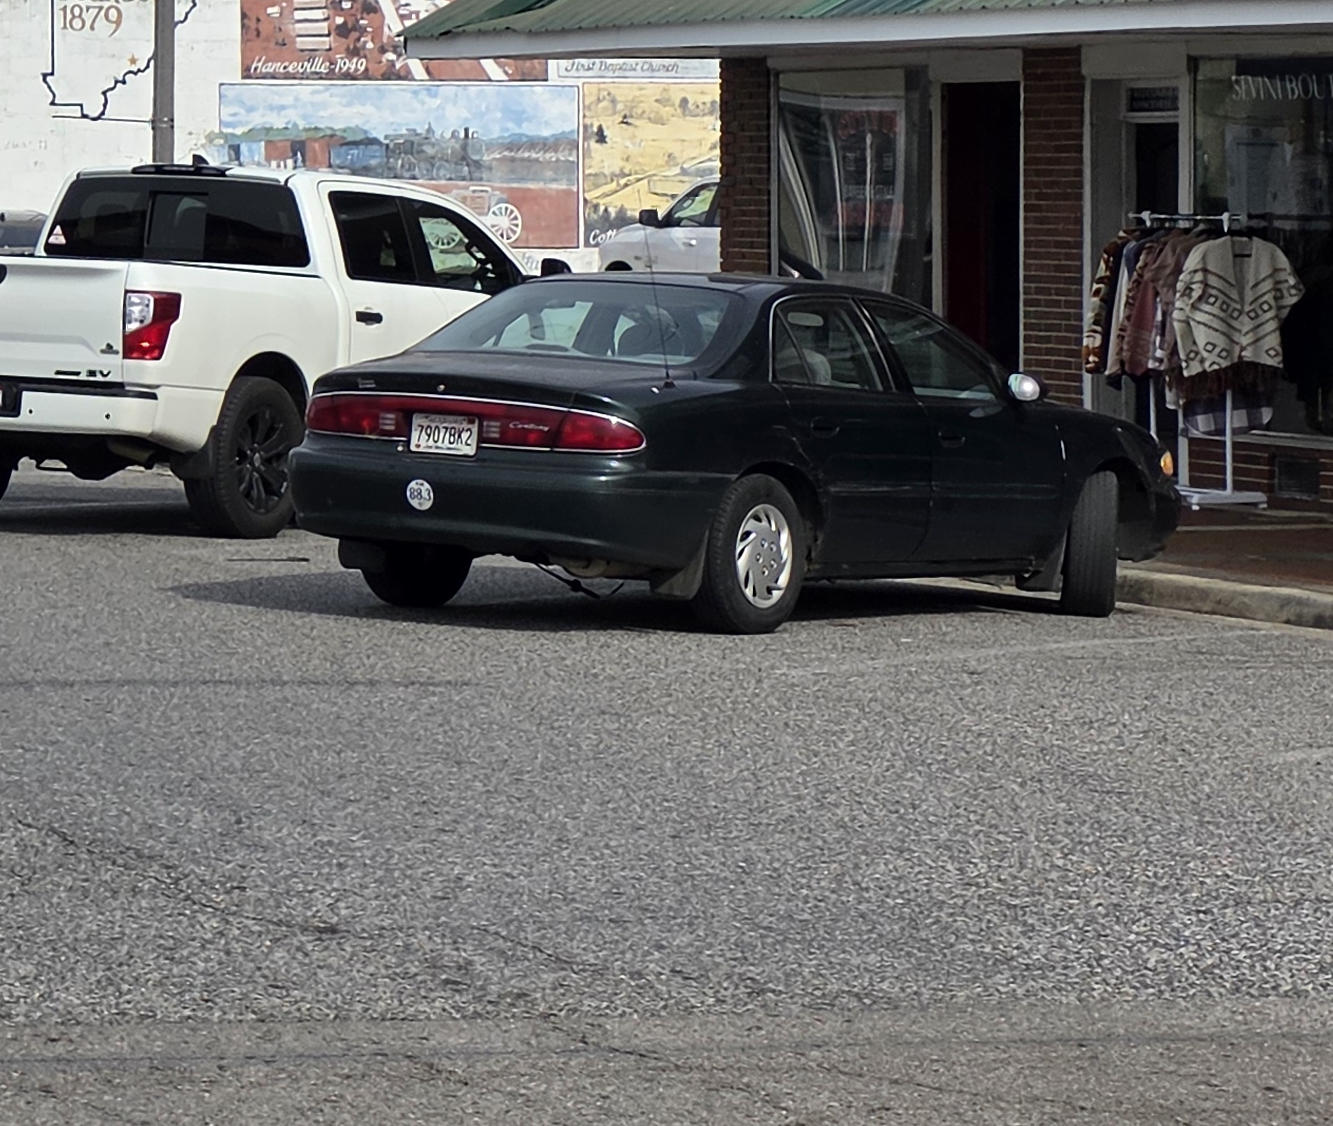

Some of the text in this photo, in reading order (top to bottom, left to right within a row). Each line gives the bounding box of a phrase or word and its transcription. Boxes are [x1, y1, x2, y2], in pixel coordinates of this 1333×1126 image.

[60, 4, 123, 38] 1879
[598, 60, 639, 74] Baptist
[641, 60, 679, 73] Church
[409, 487, 432, 501] 88.3
